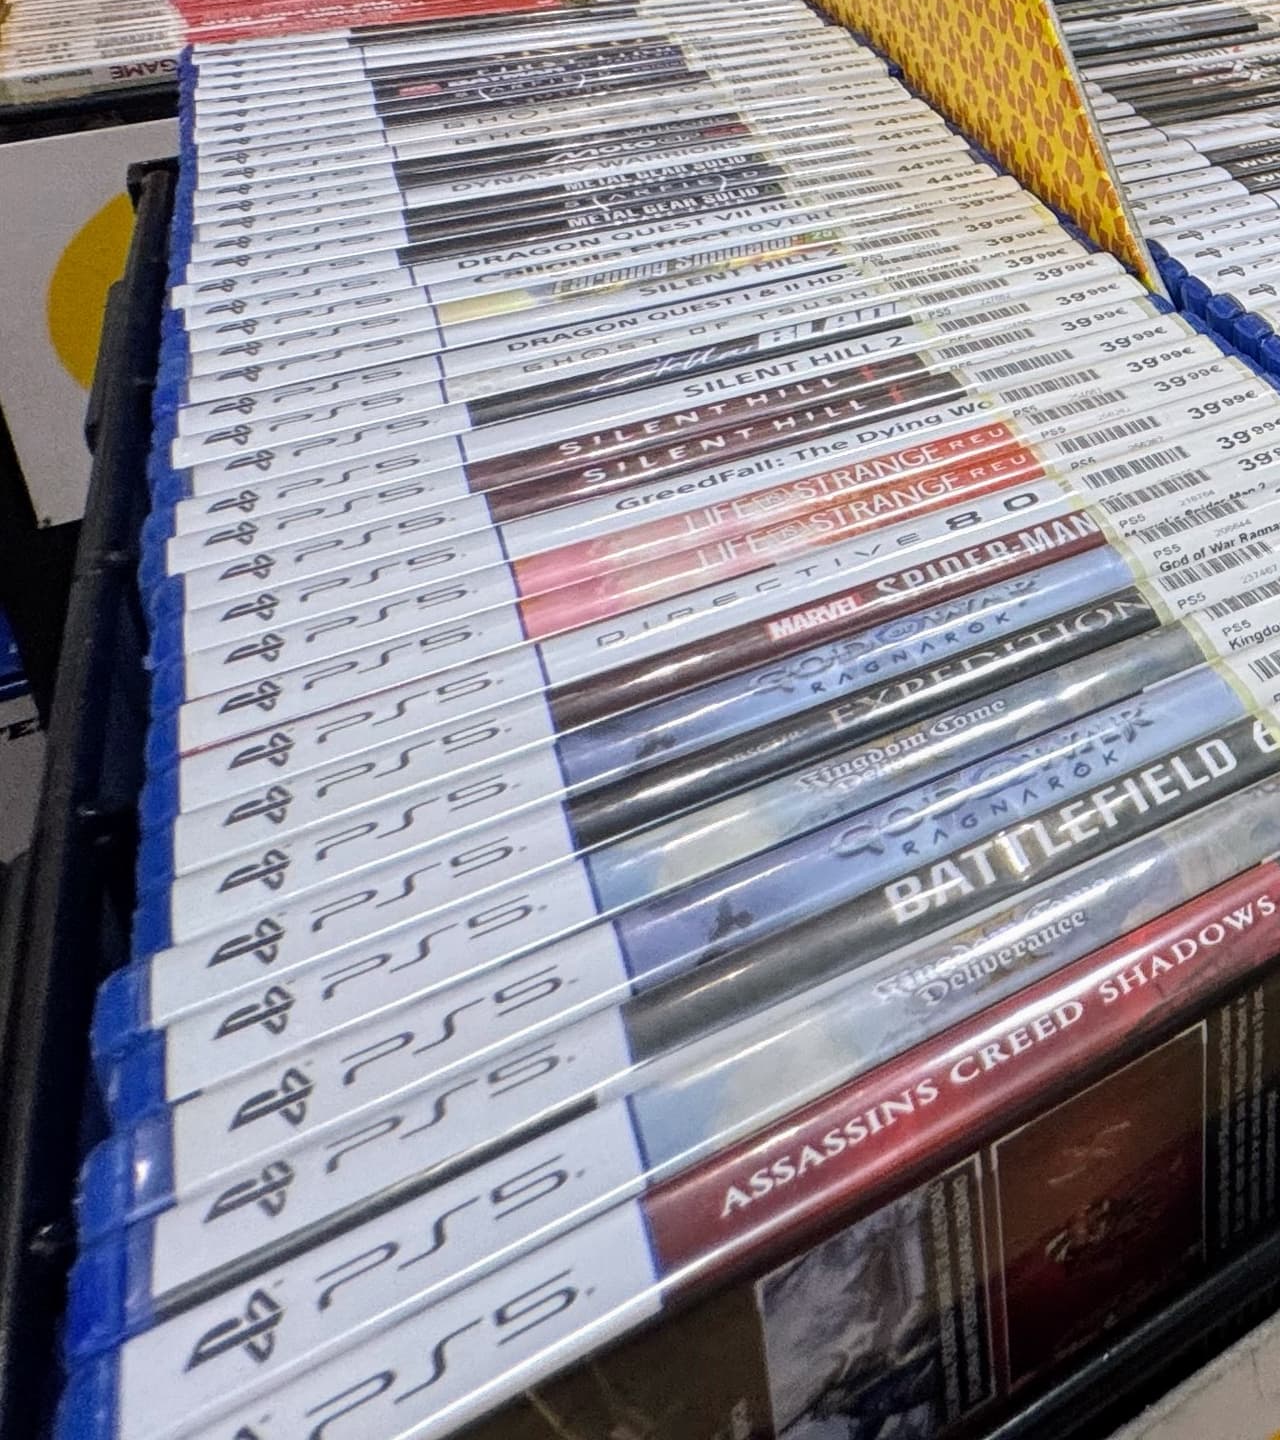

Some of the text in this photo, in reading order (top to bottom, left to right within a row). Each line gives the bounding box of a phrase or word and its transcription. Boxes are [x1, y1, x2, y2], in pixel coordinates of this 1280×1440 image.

[457, 216, 704, 271] DRAGON QUEST
[560, 374, 840, 458] SILENT HILL
[614, 409, 945, 514] GreedFall: The Dying
[682, 443, 942, 536] LIFE STRANGE
[767, 510, 1100, 642] MARVEL SPIDER-MAN
[1221, 619, 1252, 637] PS5
[827, 596, 1152, 732] EXPEDITION
[883, 735, 1240, 926] BATTLEFIELD
[720, 1080, 940, 1218] ASSASSINS
[949, 1001, 1086, 1087] CREED
[1098, 893, 1277, 1005] SHADOWS
[316, 1163, 568, 1311] PS5
